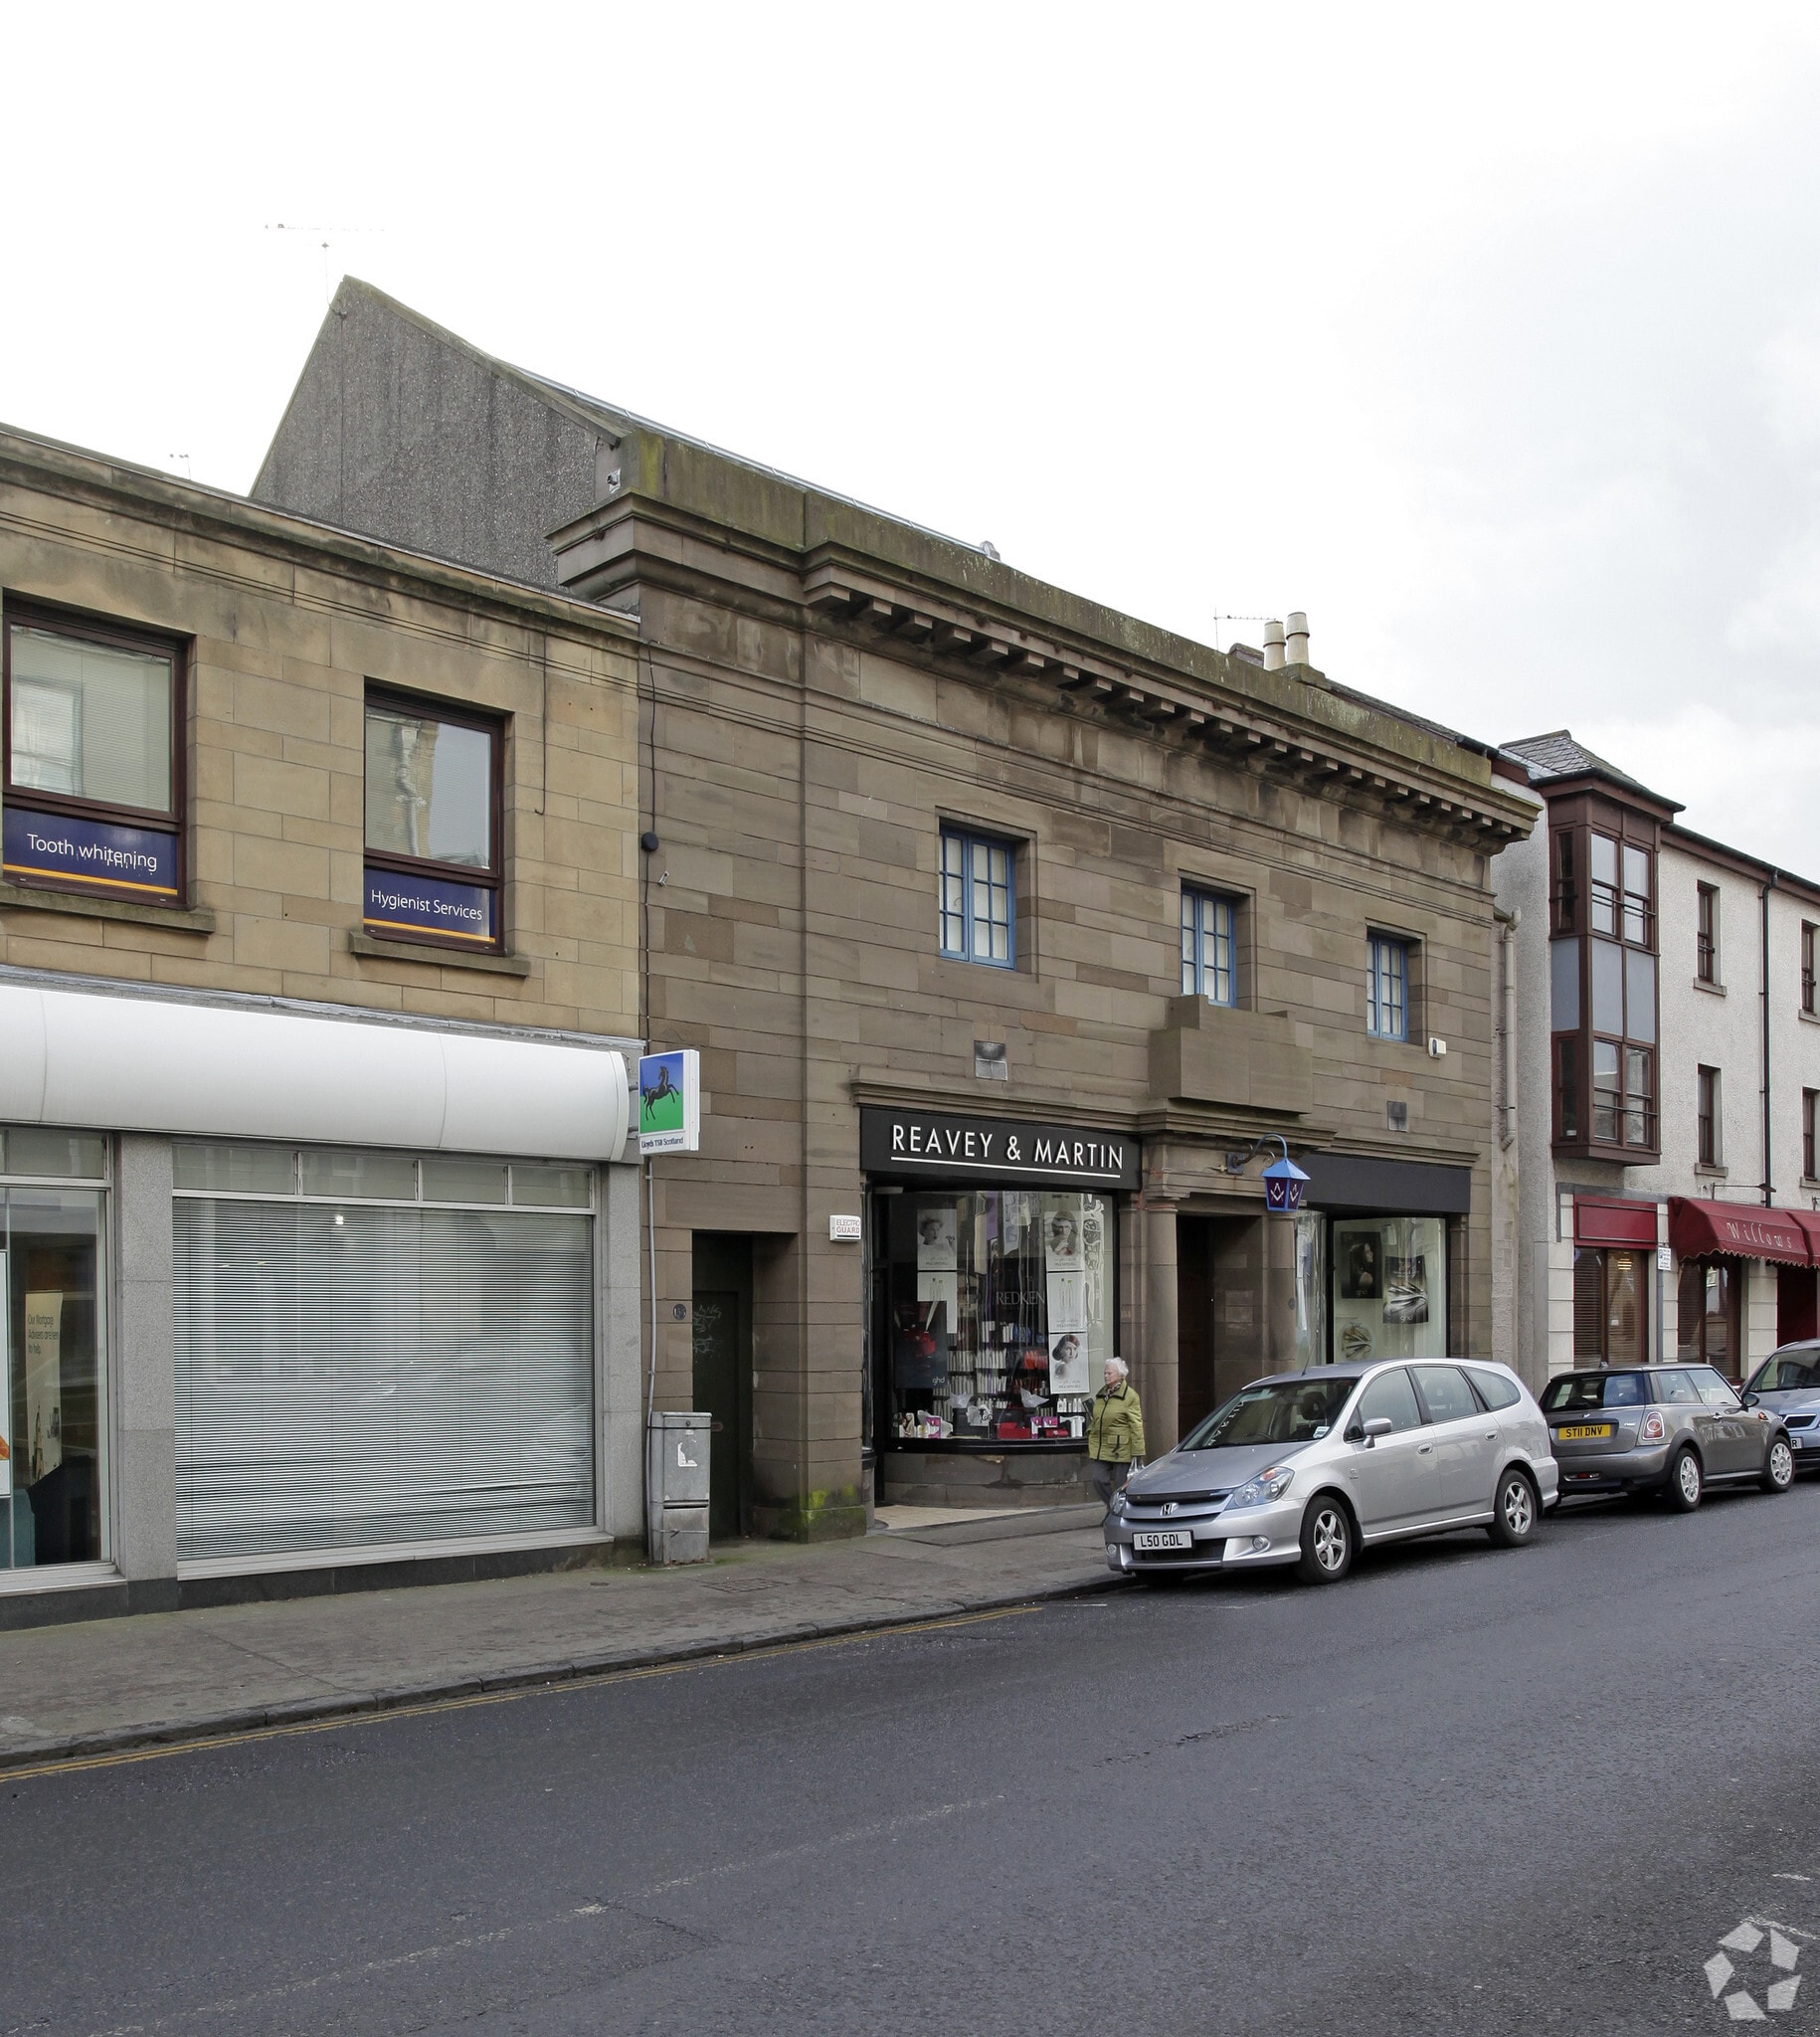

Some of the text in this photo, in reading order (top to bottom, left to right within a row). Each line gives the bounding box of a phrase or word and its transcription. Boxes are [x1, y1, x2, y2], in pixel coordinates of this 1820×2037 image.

[27, 833, 157, 872] Tooth whitening
[371, 889, 483, 921] Hygienist Services
[892, 1124, 1123, 1170] REAVEY & MARTIN
[1727, 1222, 1792, 1249] Willows
[996, 1291, 1045, 1305] REDKEN
[932, 1377, 945, 1386] ghd
[1566, 1426, 1603, 1438] ST11 DNV
[1141, 1534, 1183, 1548] L50 GDL
